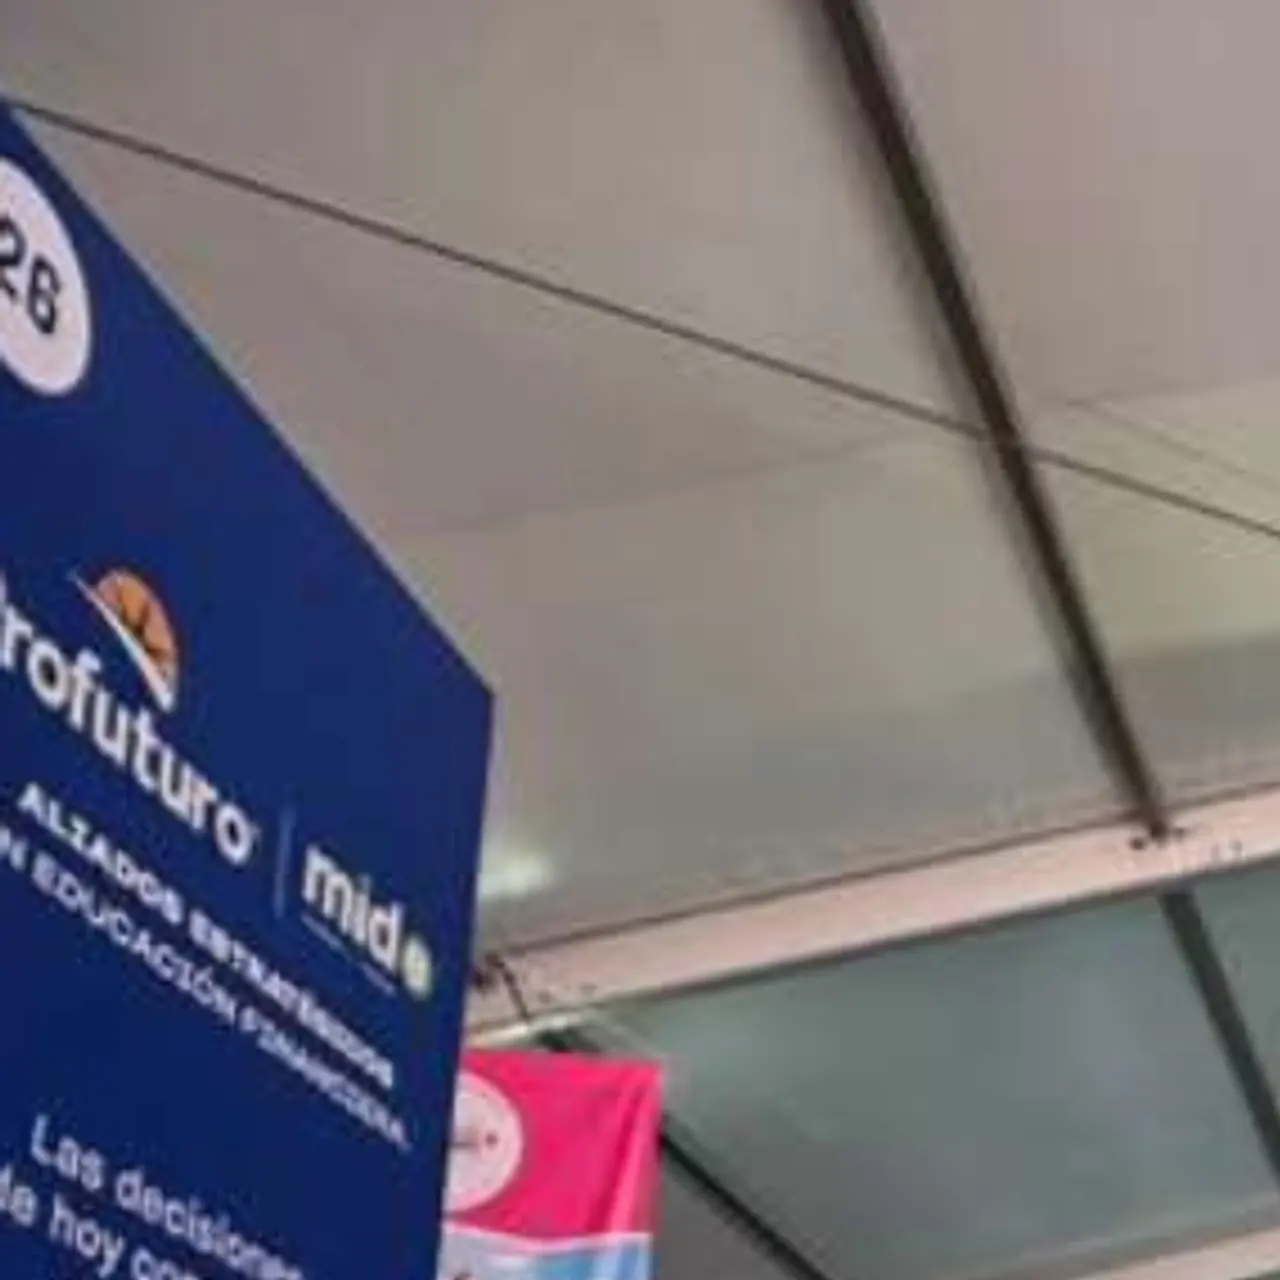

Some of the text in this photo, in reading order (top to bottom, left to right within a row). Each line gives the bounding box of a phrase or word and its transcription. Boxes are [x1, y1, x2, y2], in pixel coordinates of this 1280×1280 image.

[0, 580, 252, 866] rofuturo
[31, 1113, 104, 1191] Las
[49, 1191, 125, 1279] hoy
